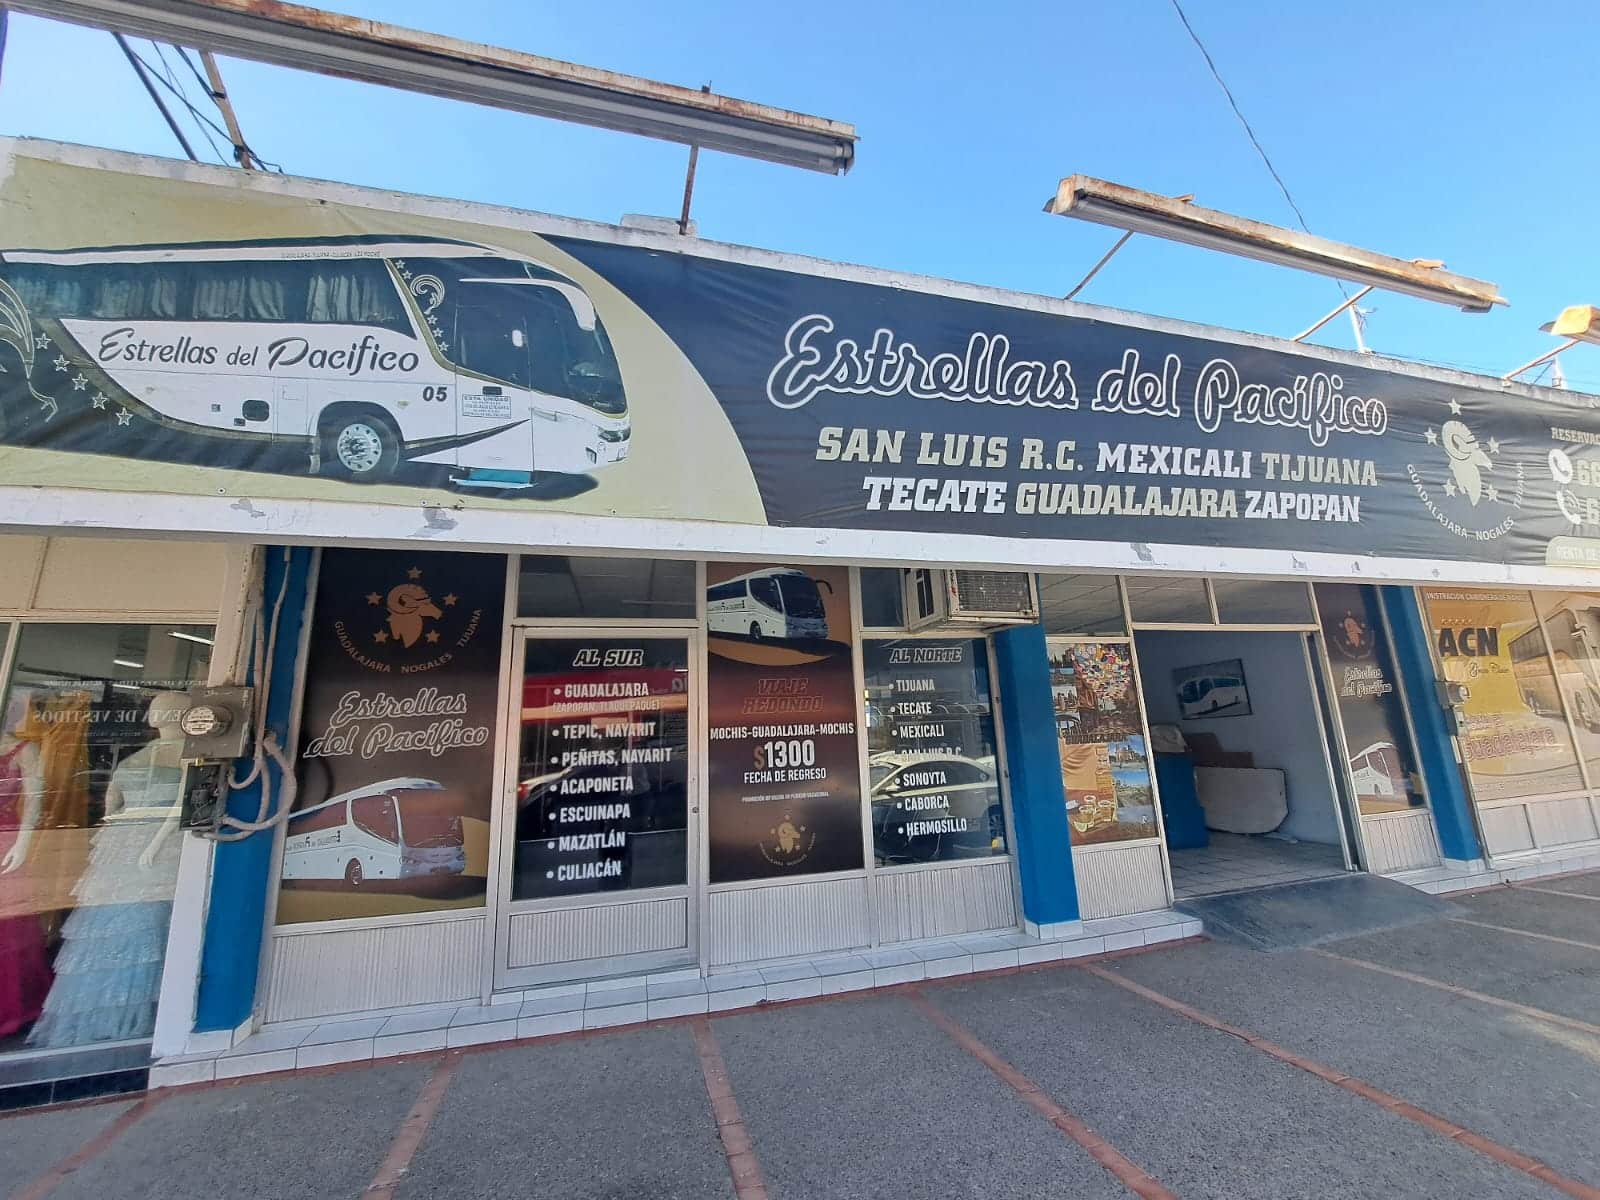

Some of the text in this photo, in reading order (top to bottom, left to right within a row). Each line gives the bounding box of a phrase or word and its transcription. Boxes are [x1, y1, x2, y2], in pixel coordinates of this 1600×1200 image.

[99, 327, 217, 364] Estrellas
[226, 345, 257, 367] del
[766, 313, 1389, 448] Estrellas del Pacífico
[422, 386, 448, 402] 05
[816, 426, 1378, 487] SAN LUIS R.C. MEXICALI TIJUANA
[862, 476, 1361, 523] TECATE GUADALAJARA ZAPOPAN
[1407, 463, 1469, 540] GUADALAJARA
[1475, 515, 1515, 541] NOGALES
[334, 608, 482, 674] GUADALAJARA NOGALES TIJUANA
[1438, 627, 1499, 657] ACN
[572, 649, 645, 667] AL SUR
[889, 647, 963, 663] AL NORTE
[564, 682, 650, 698] GUADALAJARA
[895, 679, 936, 692] TIJUANA
[330, 687, 468, 729] Estrellas
[897, 701, 933, 715] TECATE
[562, 722, 657, 740] TEPIC, NAYARIT
[900, 724, 945, 739] MEXICALI
[303, 725, 360, 759] del
[561, 747, 673, 767] PEÑITAS, NAYARIT
[753, 739, 816, 770] $1300
[560, 776, 634, 795] ACAPONETA
[744, 767, 827, 784] FECHA DE REGRESO
[903, 771, 947, 787] SONOYTA
[560, 803, 631, 823] ESCUINAPA
[904, 795, 950, 811] CABORCA
[906, 818, 967, 836] HERMOSILLO
[559, 828, 626, 852] MAZATLÁN
[557, 857, 622, 881] CULIACÁN
